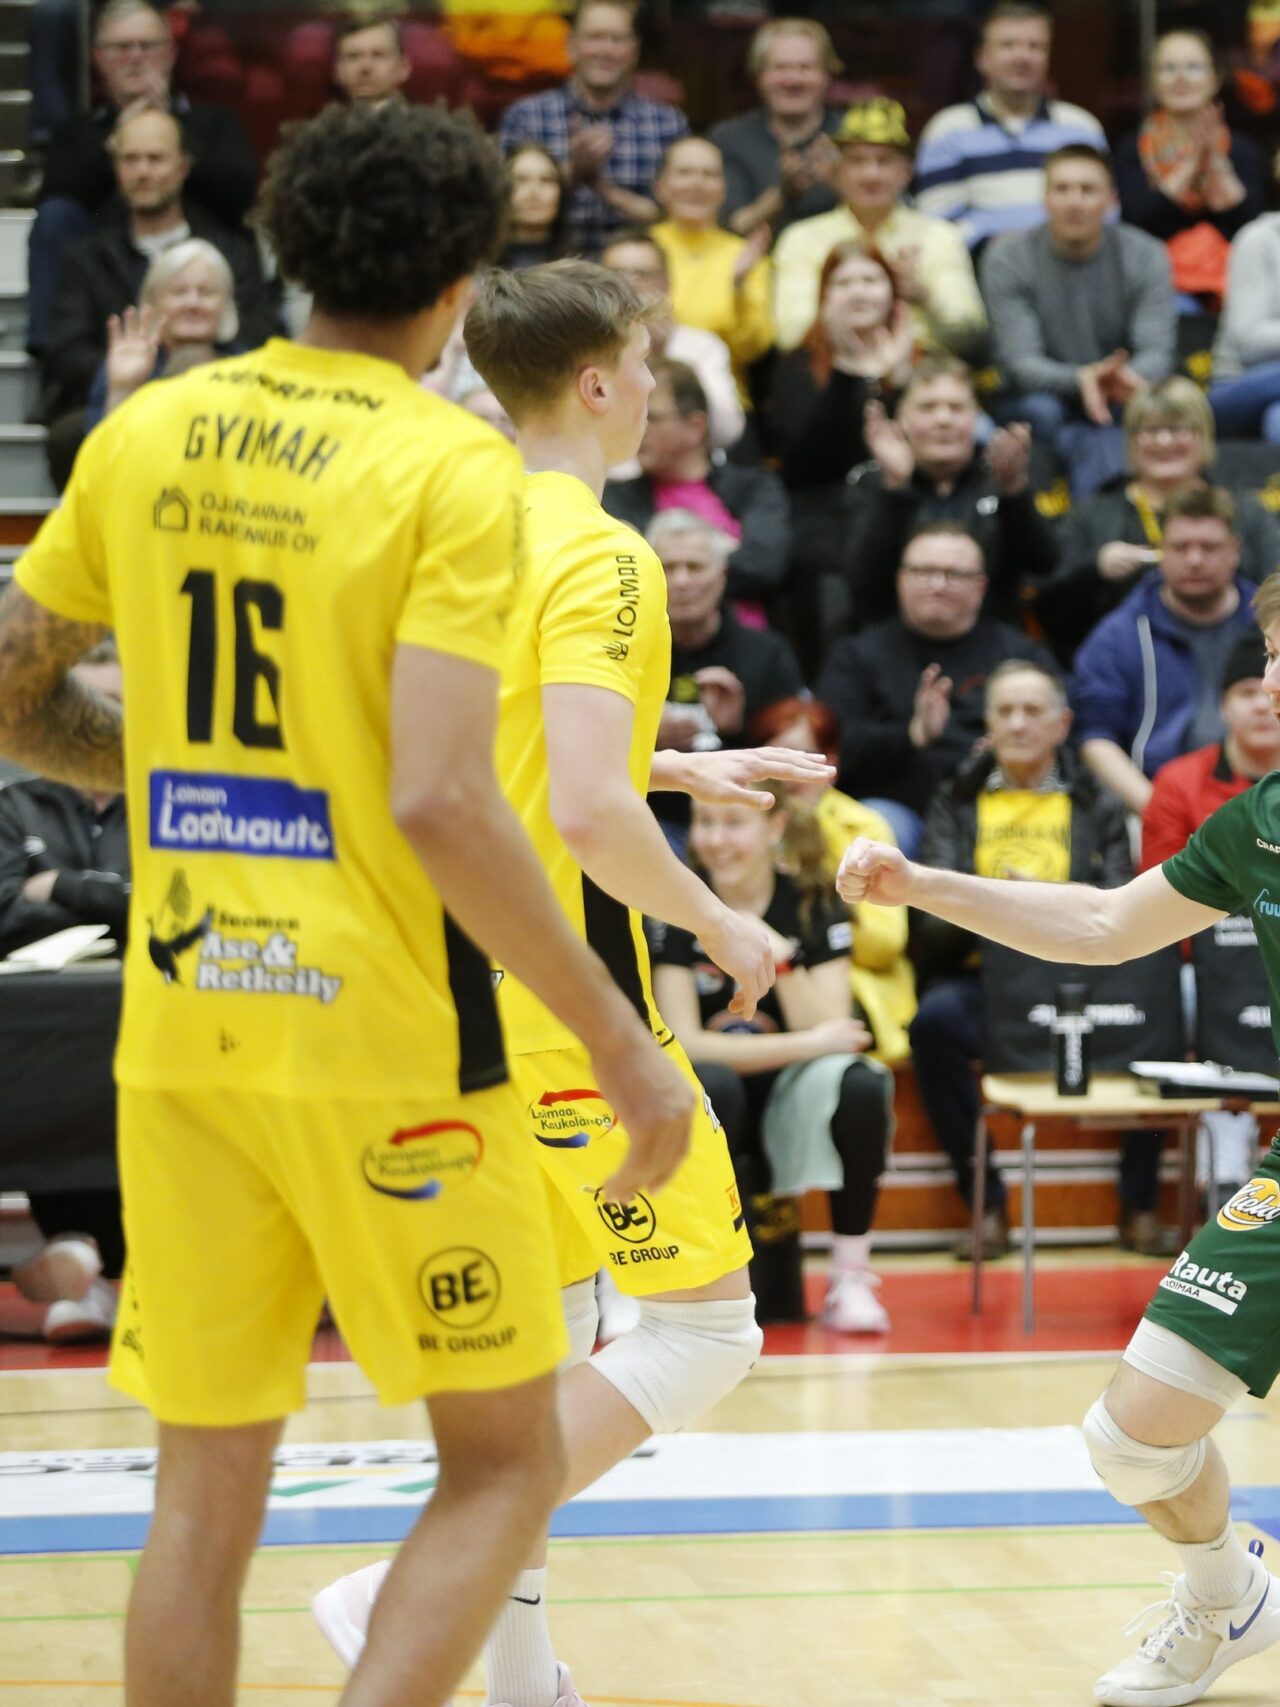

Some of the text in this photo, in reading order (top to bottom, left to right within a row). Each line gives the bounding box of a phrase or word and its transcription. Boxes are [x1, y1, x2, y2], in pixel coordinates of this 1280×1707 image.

[184, 414, 341, 483] GYIMAH
[613, 555, 641, 637] LOIMAA
[180, 567, 288, 752] 16
[159, 801, 331, 850] Laatuauto
[201, 931, 262, 961] Ase
[602, 1201, 649, 1231] BE
[630, 1245, 680, 1264] GROUP
[1170, 1250, 1248, 1301] Rauta
[430, 1258, 491, 1312] BE
[418, 1327, 517, 1352] BE GROUP
